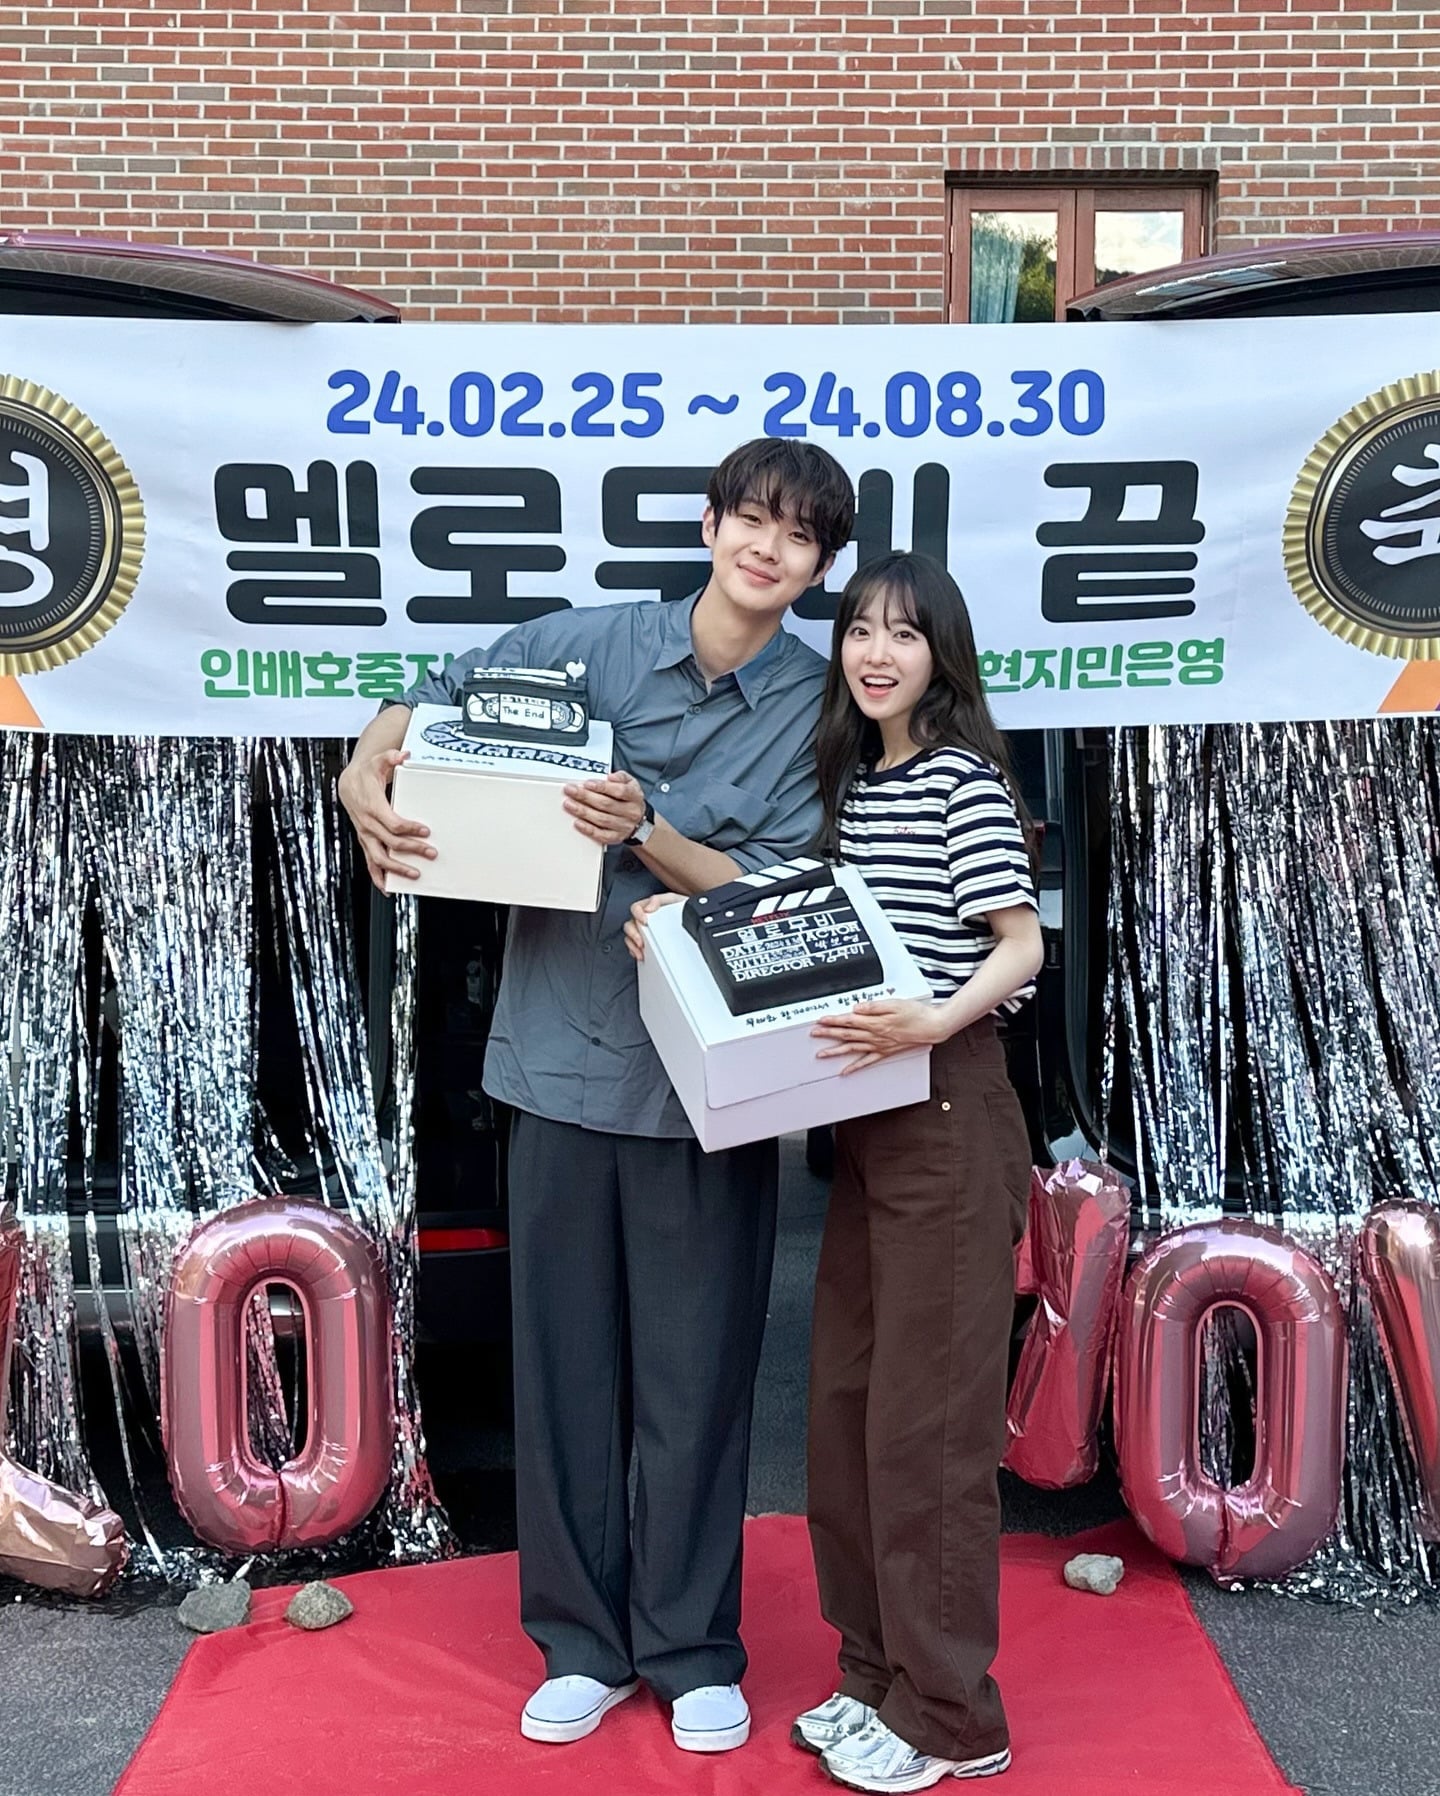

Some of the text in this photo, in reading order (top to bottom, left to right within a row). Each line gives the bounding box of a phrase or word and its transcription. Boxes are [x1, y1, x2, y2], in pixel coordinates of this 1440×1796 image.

[327, 370, 664, 438] 24.02.25
[763, 369, 1105, 438] 24.08.30
[1036, 461, 1206, 622] 끝
[502, 706, 545, 719] The End
[805, 921, 861, 942] ACTOR
[721, 943, 765, 959] DATE
[727, 955, 770, 971] WITH
[732, 957, 815, 982] DIRECTOR
